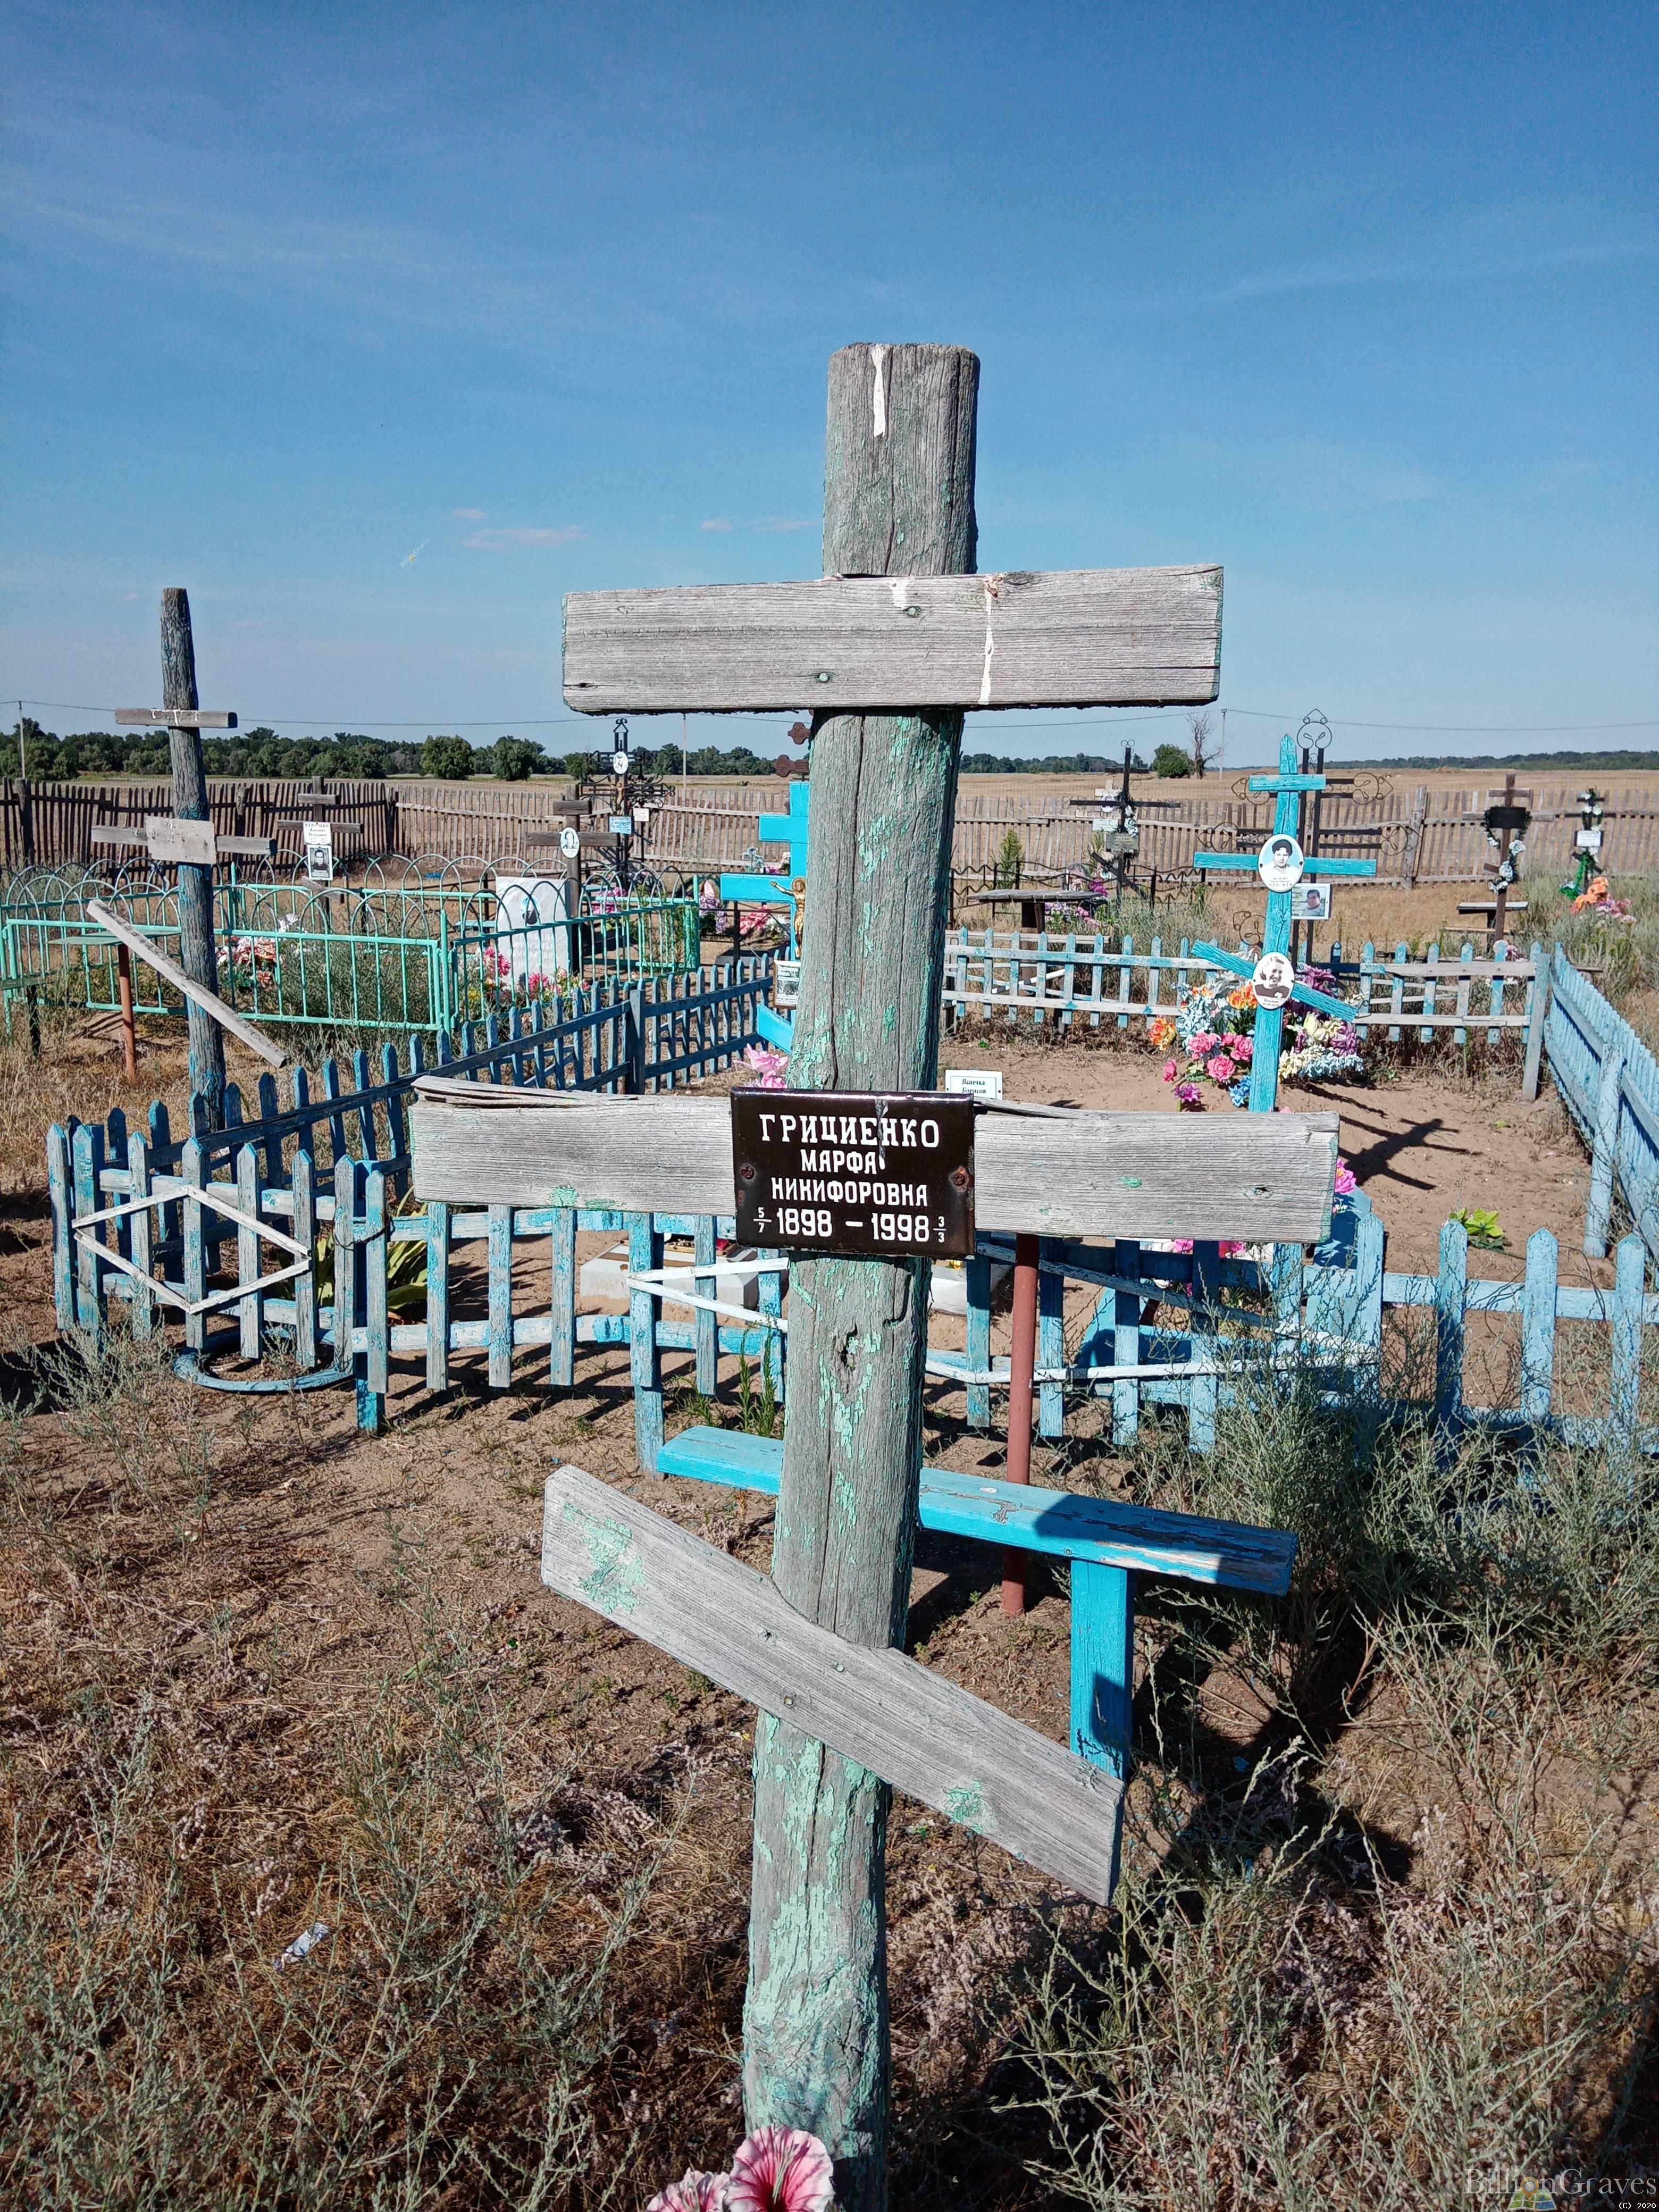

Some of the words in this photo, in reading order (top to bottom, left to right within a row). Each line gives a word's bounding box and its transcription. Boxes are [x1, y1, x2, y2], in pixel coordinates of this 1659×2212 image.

[759, 1114, 940, 1148] ГРИЦИЕНКО
[800, 1149, 877, 1175] МАРФА
[771, 1177, 928, 1206] НИКИФОРОВНА
[776, 1208, 833, 1237] 1898
[871, 1212, 930, 1243] 1998
